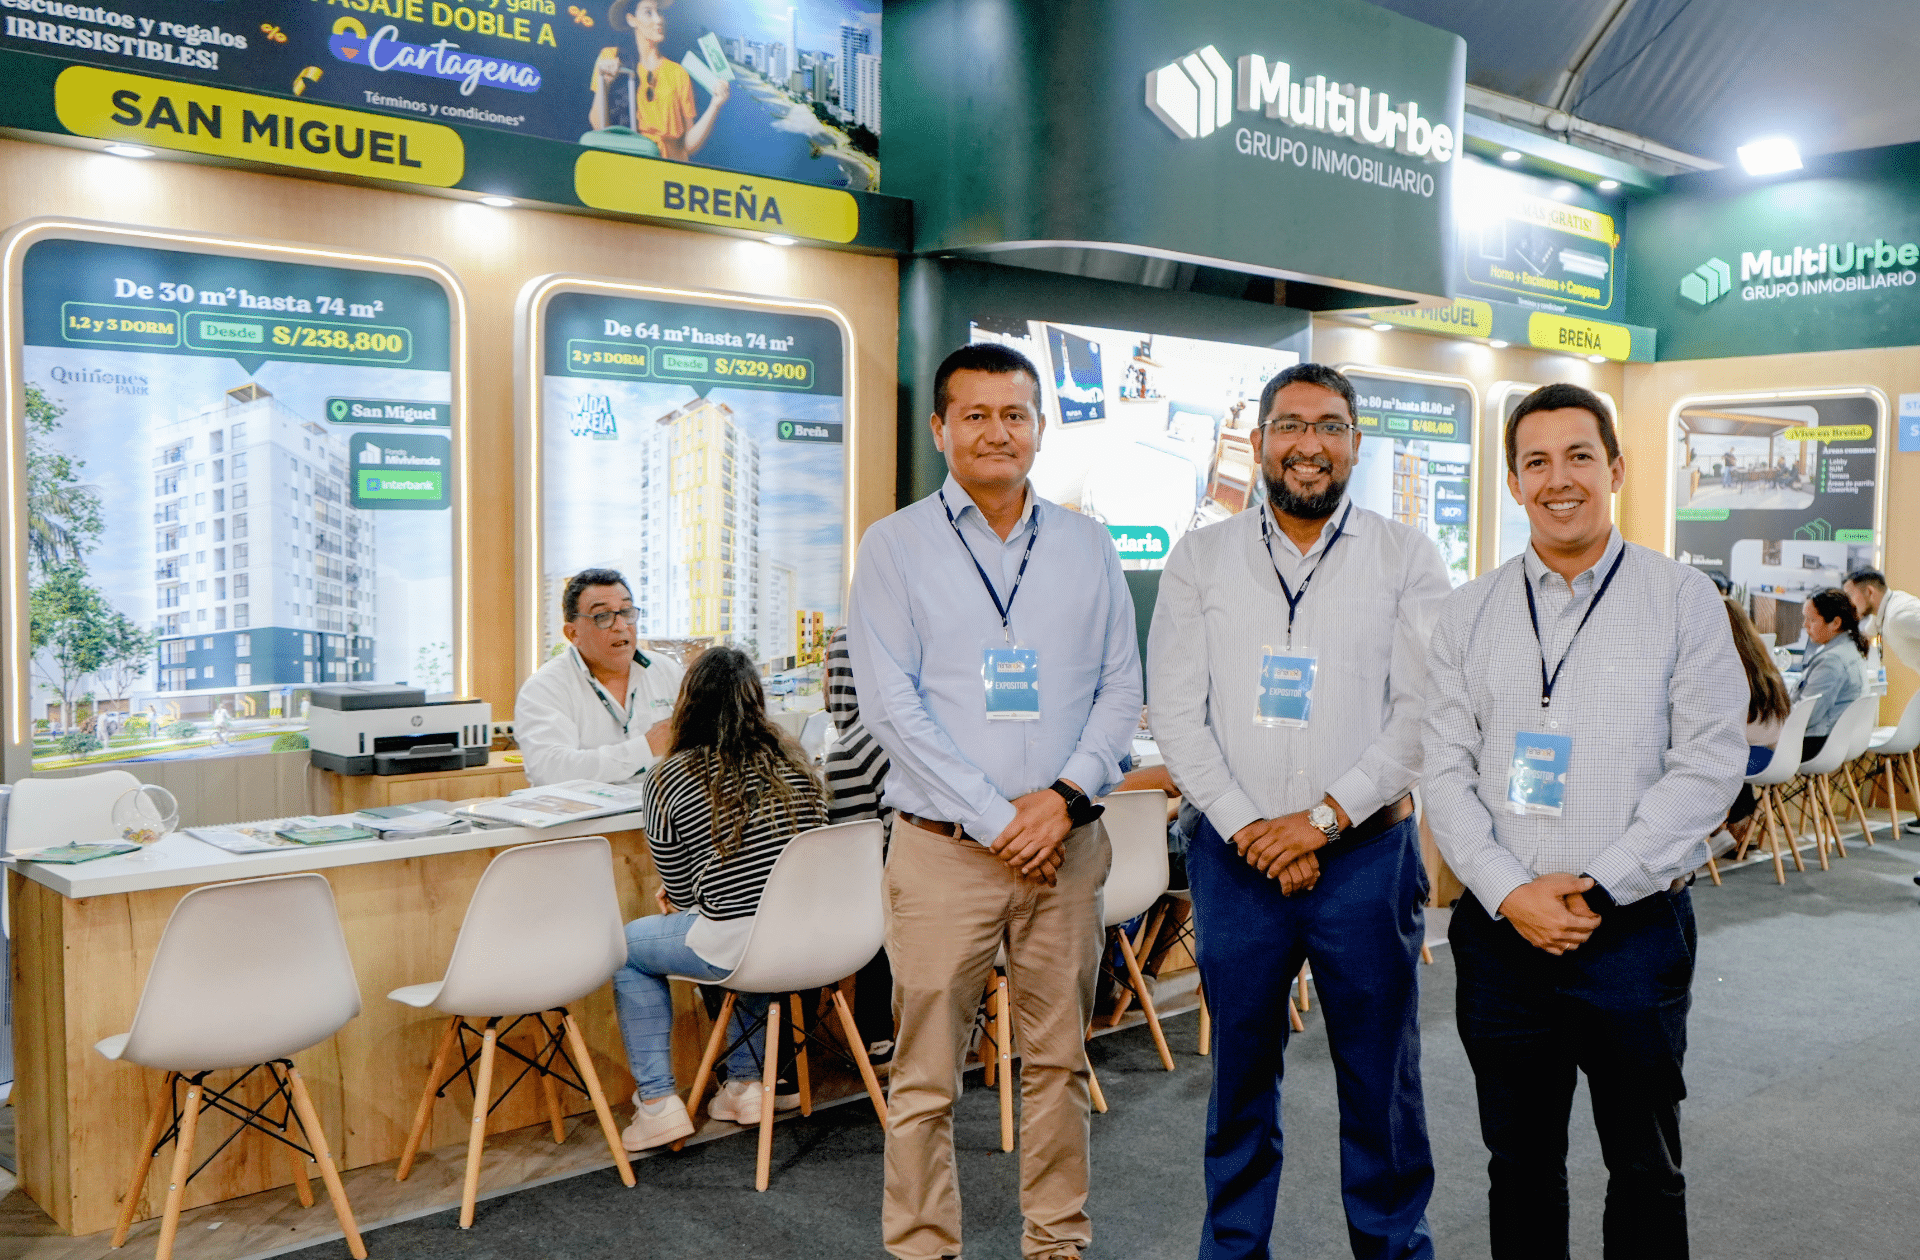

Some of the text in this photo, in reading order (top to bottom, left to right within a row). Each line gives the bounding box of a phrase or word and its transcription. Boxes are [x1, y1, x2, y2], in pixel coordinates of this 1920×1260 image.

[138, 16, 156, 37] y
[159, 22, 248, 49] regalos
[311, 0, 557, 48] SAJE DOBLE A
[6, 16, 219, 70] IRRESISTIBLES!
[368, 24, 541, 96] Cartagena
[363, 90, 427, 112] Términos
[429, 104, 439, 116] y
[1237, 53, 1454, 163] MultiUrbe
[110, 89, 422, 168] SAN MIGUEL
[1237, 127, 1434, 198] GRUPO INMOBILIARIO
[663, 180, 783, 225] BREÑA
[1741, 238, 1920, 281] MultiUrbe
[114, 278, 154, 300] De
[159, 281, 194, 303] 30
[239, 289, 313, 313] hasta
[316, 296, 345, 316] 74
[1742, 270, 1917, 301] GRUPO INMOBILIARIO
[93, 320, 104, 332] y
[107, 318, 118, 330] 3
[121, 320, 174, 335] DORM
[206, 324, 403, 353] Desde S/238,800
[604, 319, 632, 337] De
[635, 322, 660, 340] 64
[691, 327, 743, 347] hasta
[746, 332, 767, 349] 74
[1559, 327, 1601, 350] BREÑA
[572, 350, 645, 366] 2 y 3 DORM
[715, 357, 806, 380] S/329,900
[50, 366, 148, 384] Quiñones
[115, 386, 149, 395] PARK
[1395, 398, 1420, 412] hasta
[351, 404, 437, 423] San Miguel
[795, 424, 829, 438] Breña
[1112, 533, 1162, 552] daria
[995, 681, 1028, 690] EXPOSITOR
